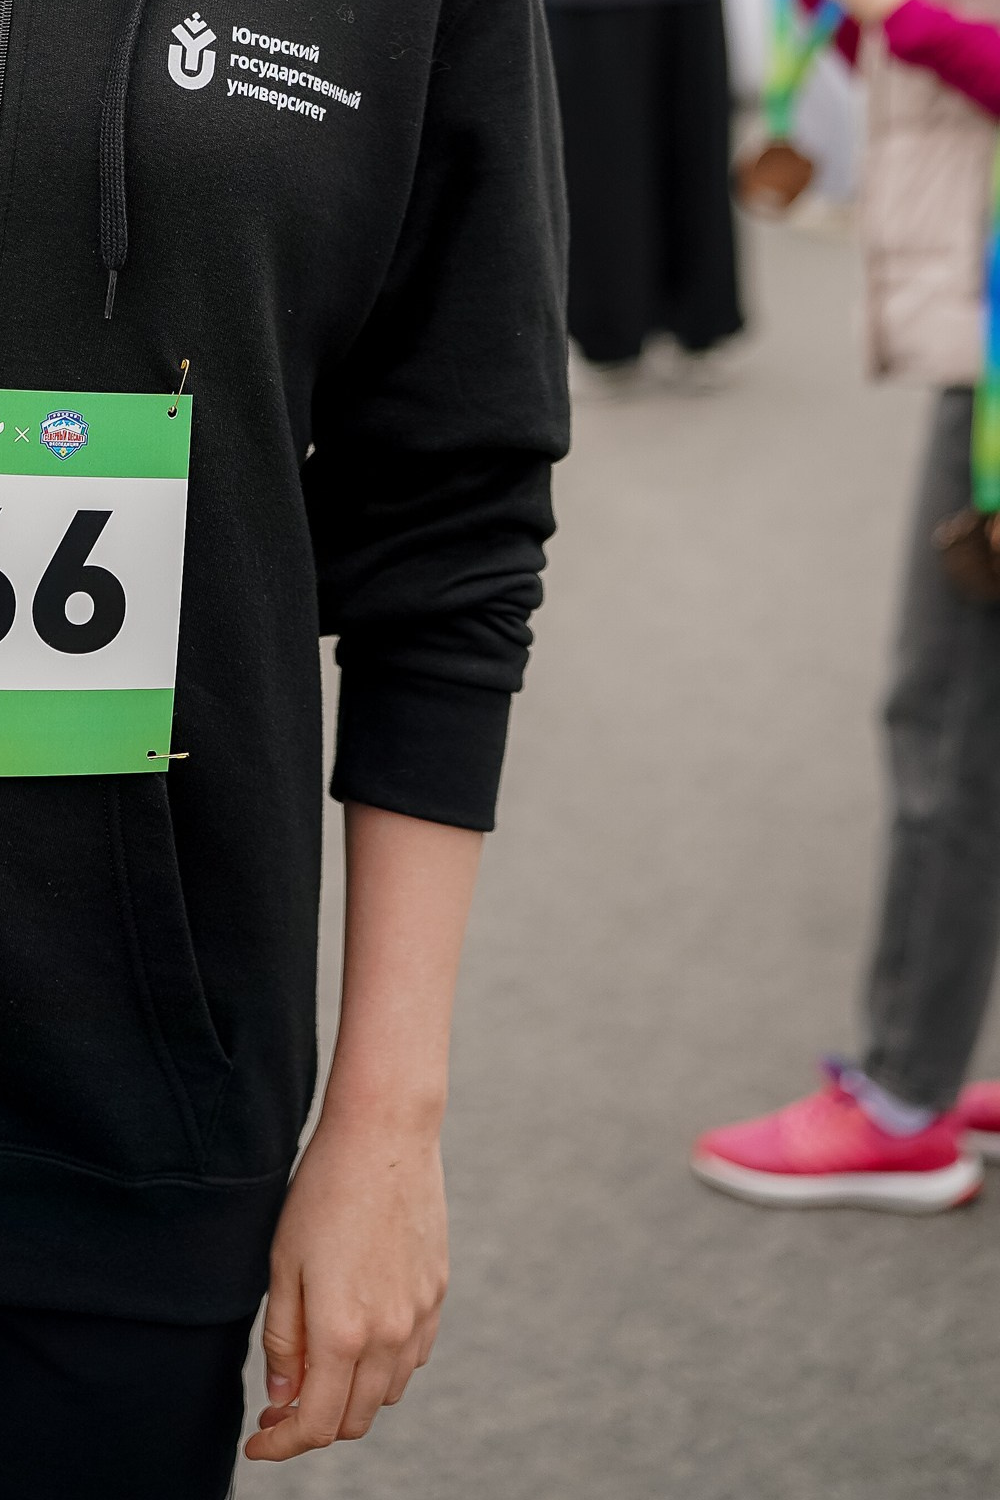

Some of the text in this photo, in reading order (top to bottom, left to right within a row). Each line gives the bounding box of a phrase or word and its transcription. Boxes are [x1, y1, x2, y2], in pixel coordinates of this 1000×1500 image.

[232, 26, 320, 63] Югорский
[226, 78, 327, 122] университет
[230, 53, 362, 110] государственный
